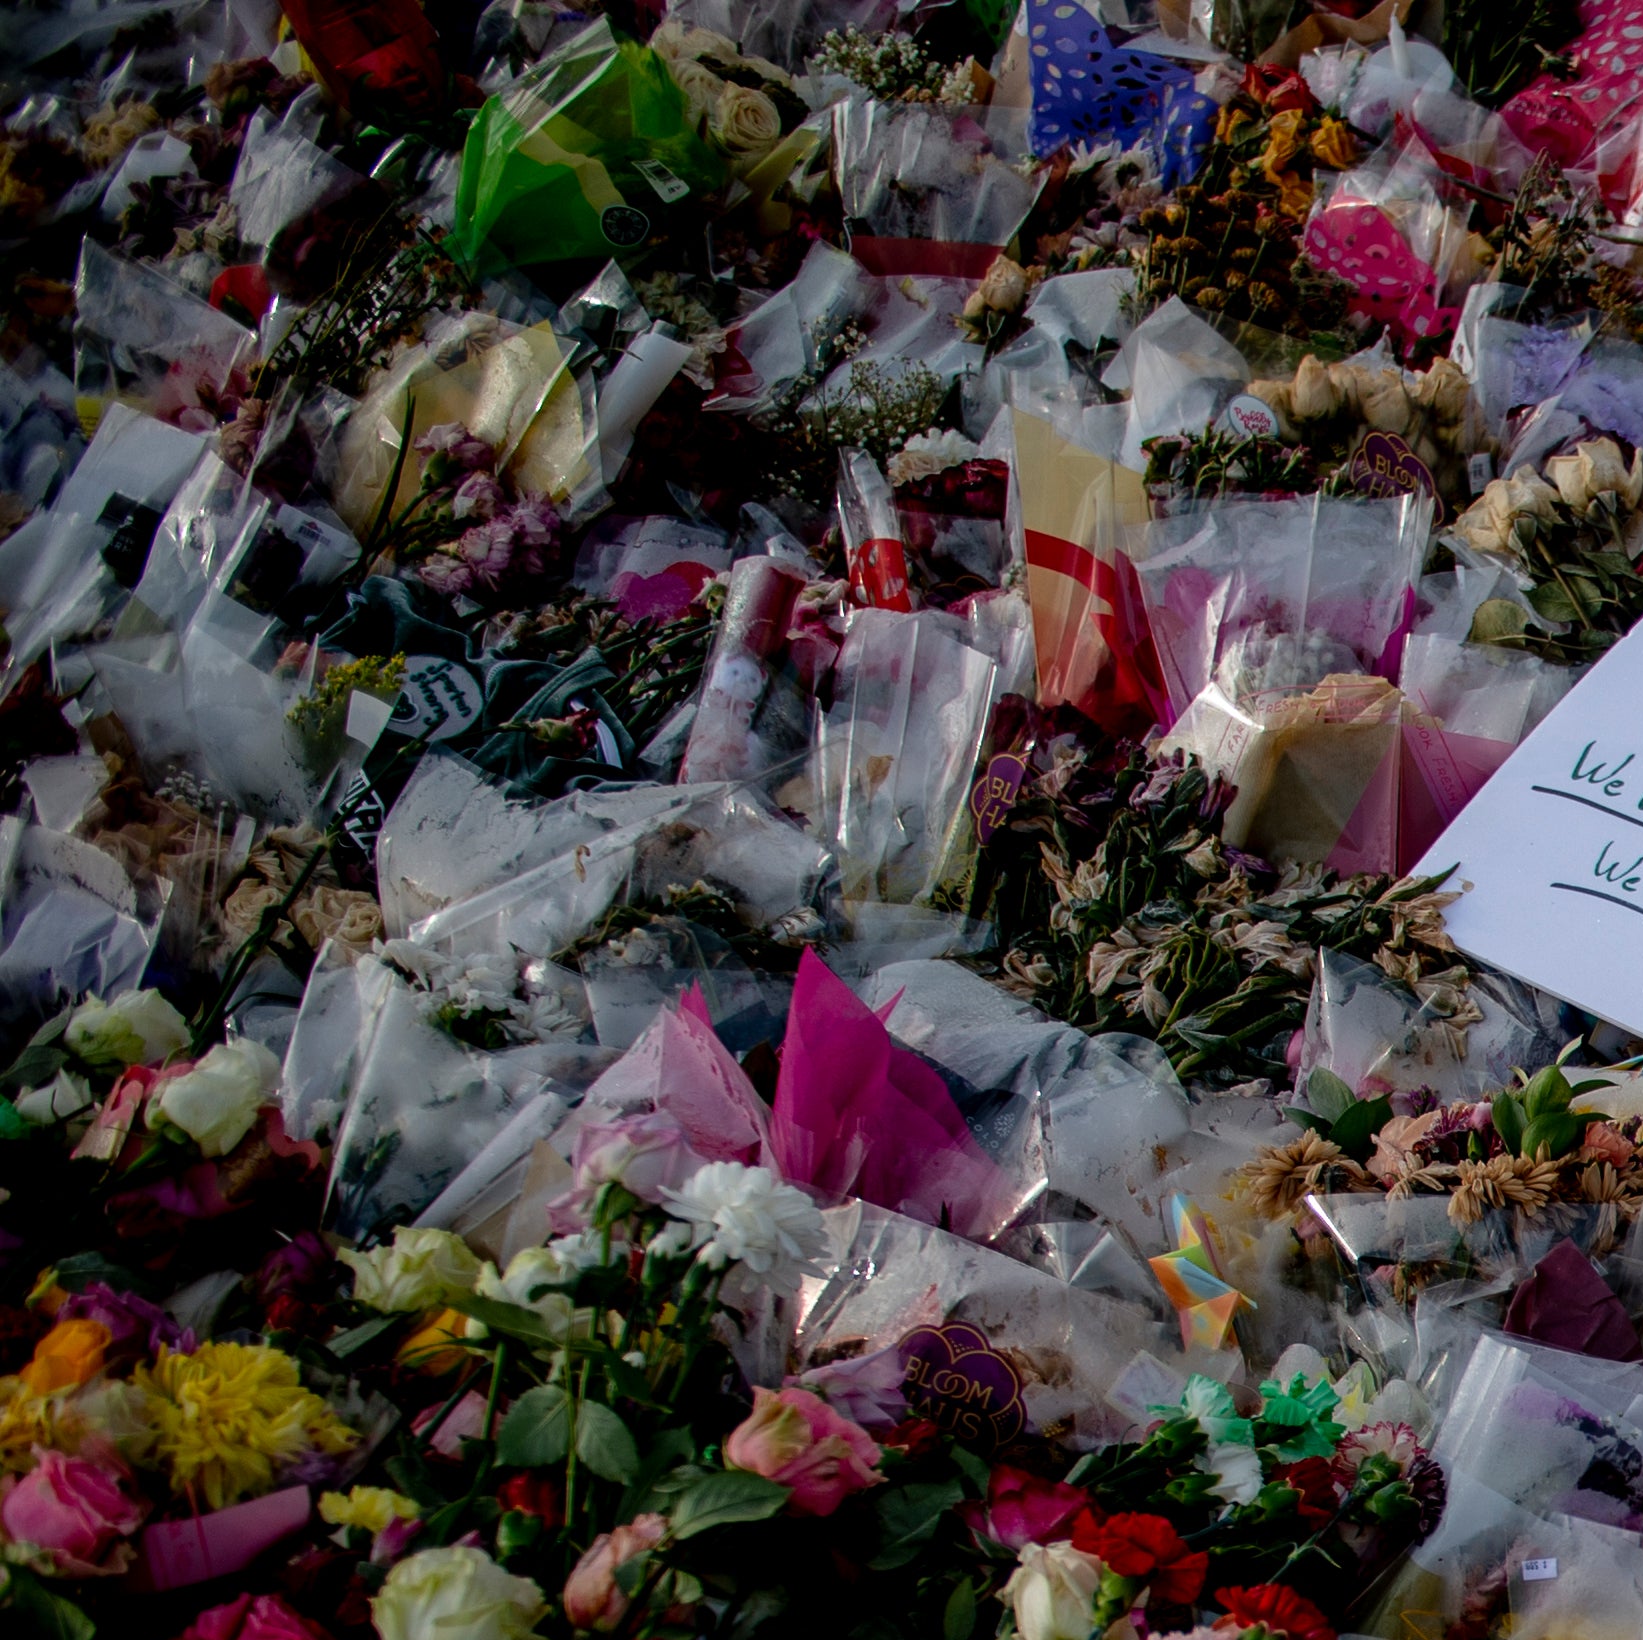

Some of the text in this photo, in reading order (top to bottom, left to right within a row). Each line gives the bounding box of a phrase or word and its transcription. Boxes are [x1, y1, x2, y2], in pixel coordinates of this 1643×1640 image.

[1227, 725, 1246, 754] FAR
[1570, 741, 1636, 797] We
[904, 1356, 994, 1411] BLOOM
